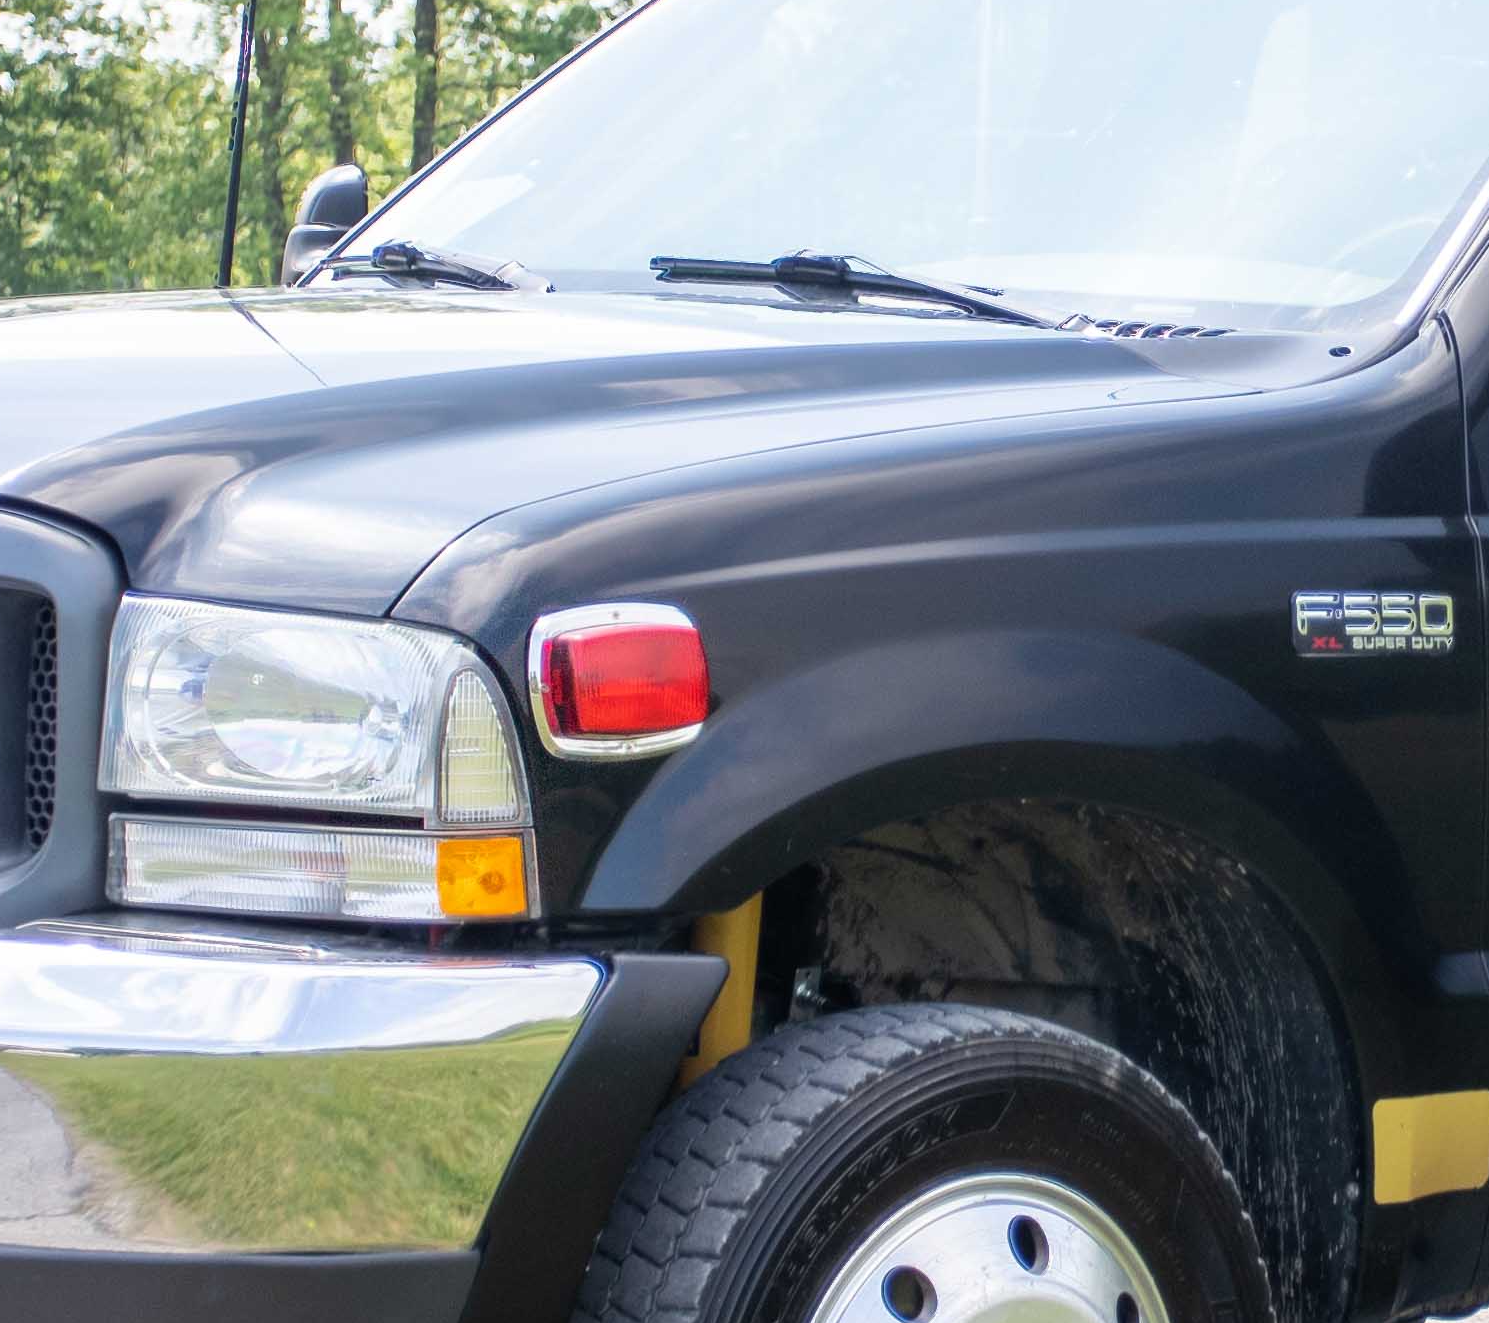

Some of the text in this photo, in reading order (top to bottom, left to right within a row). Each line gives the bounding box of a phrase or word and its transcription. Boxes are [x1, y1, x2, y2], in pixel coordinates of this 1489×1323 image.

[1312, 636, 1344, 650] XL
[1352, 636, 1454, 651] SUPER DUTY
